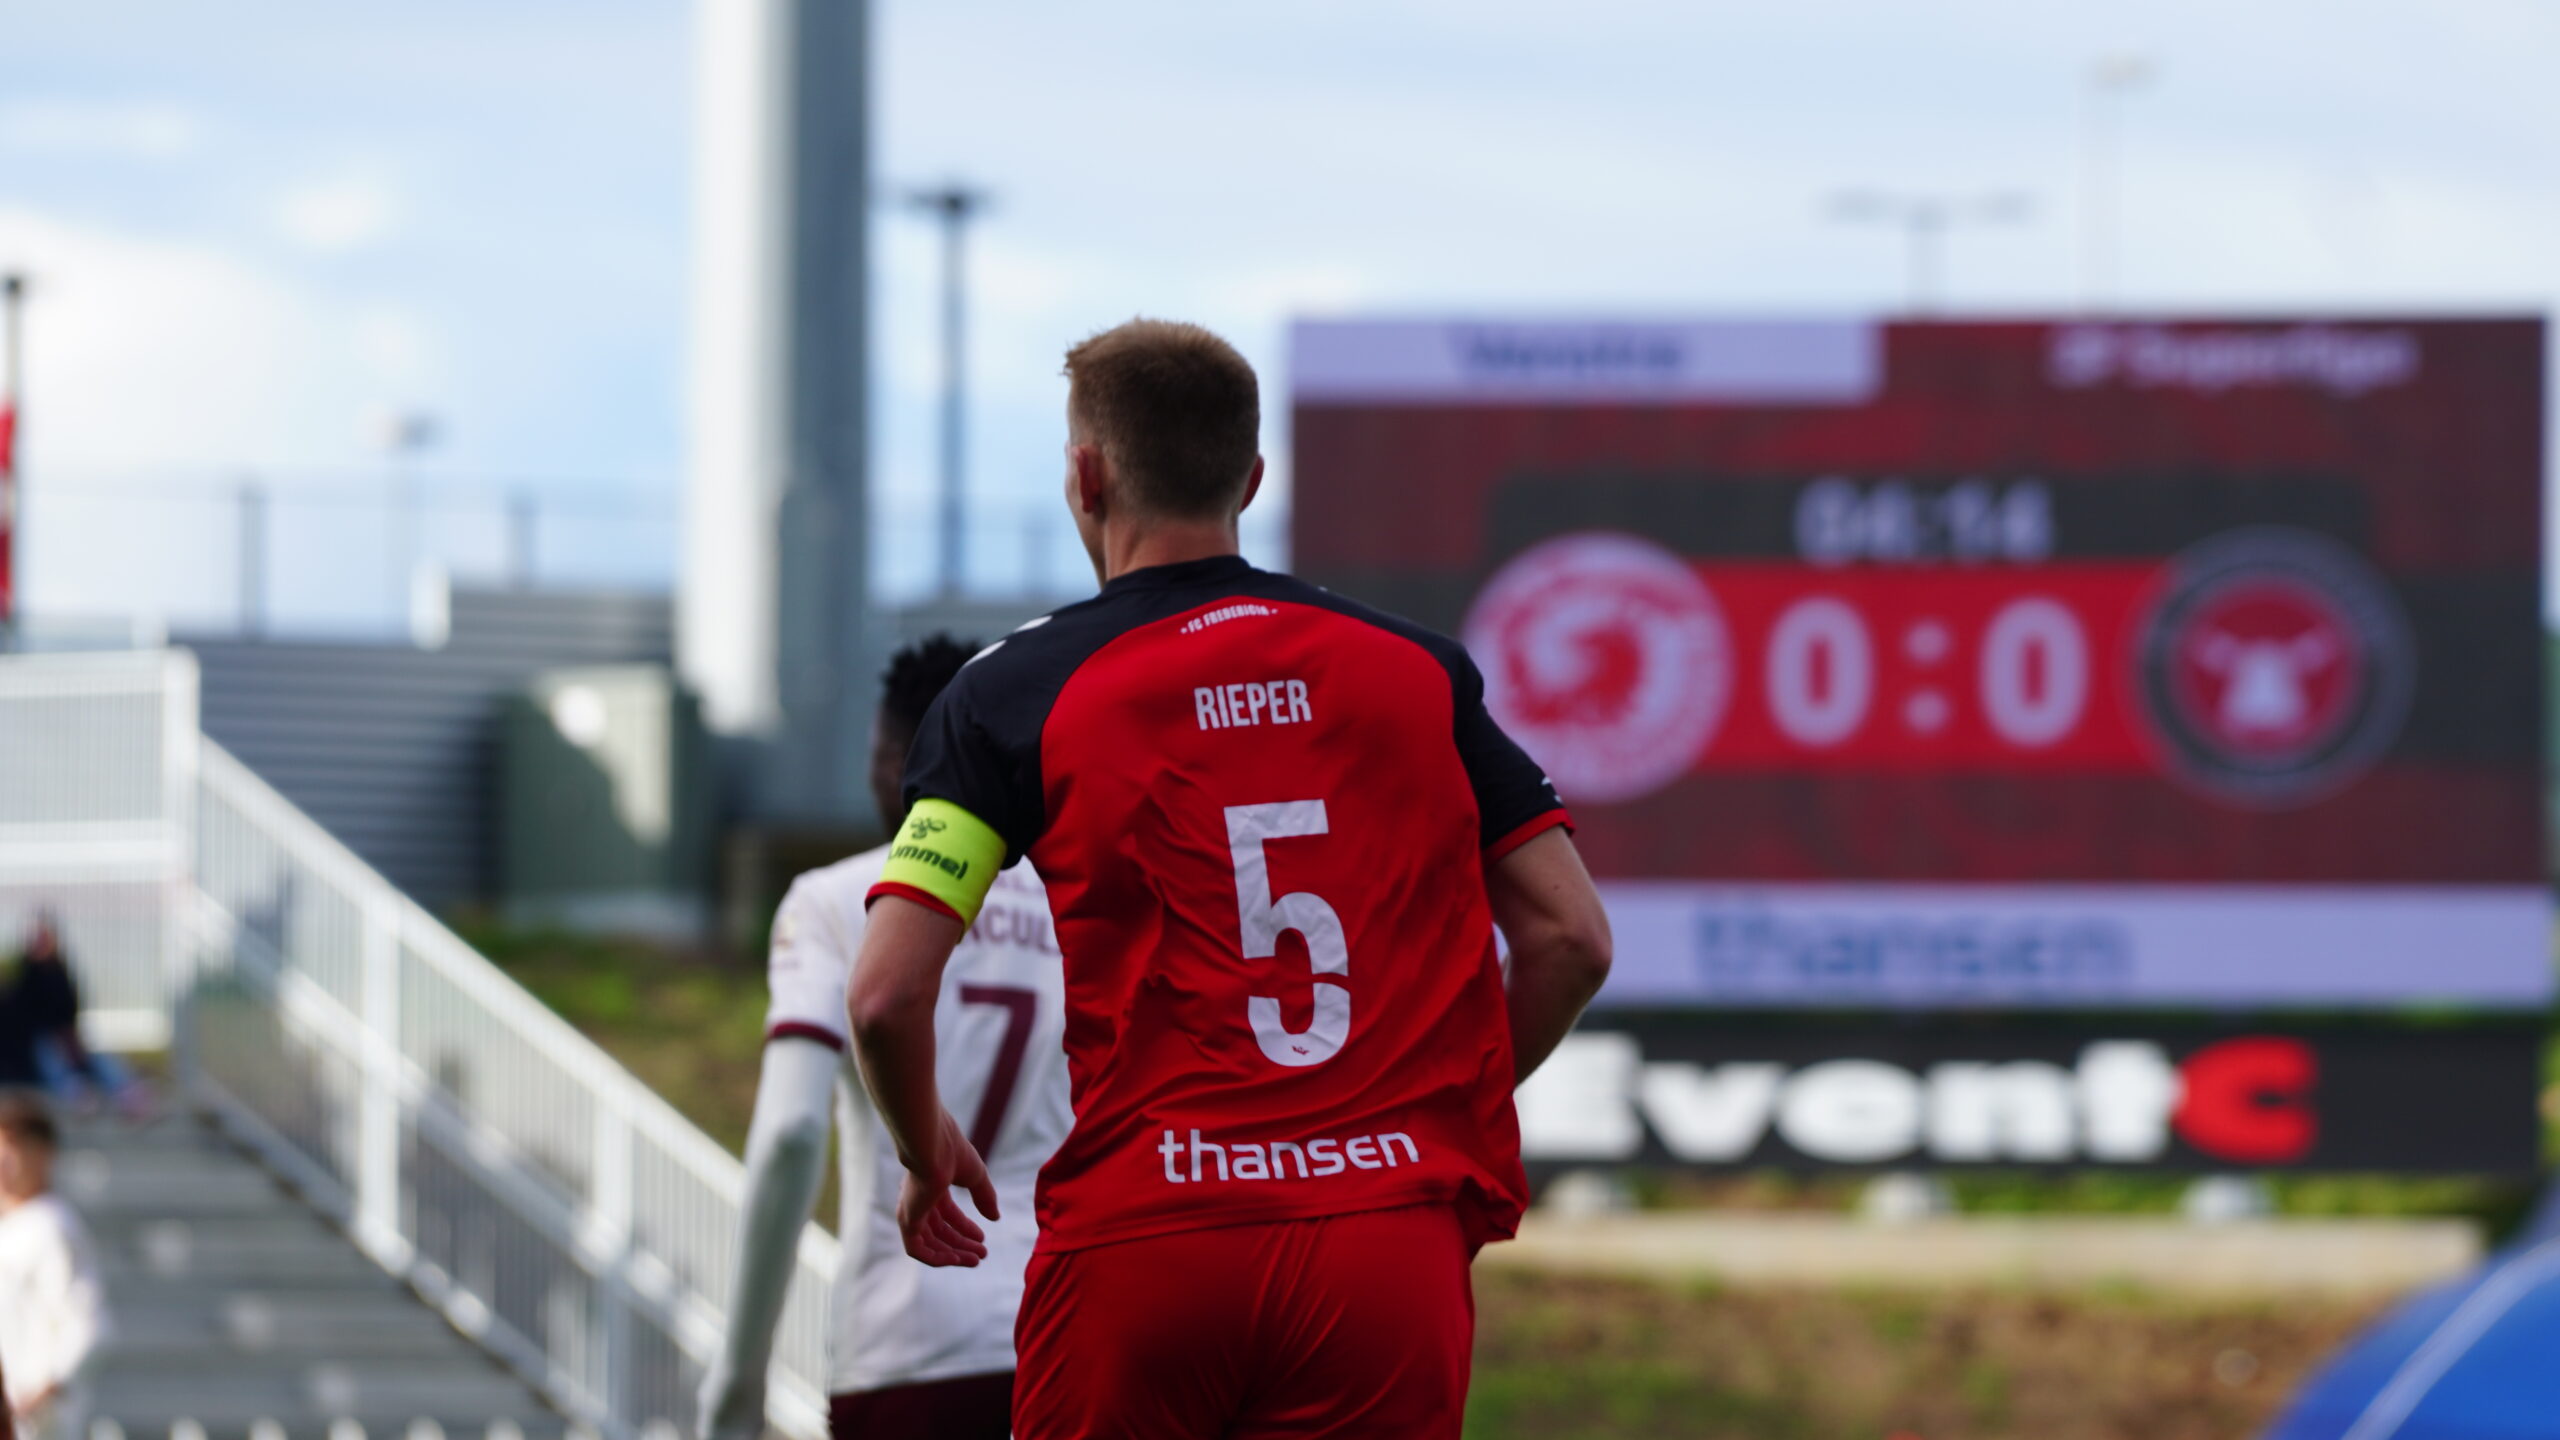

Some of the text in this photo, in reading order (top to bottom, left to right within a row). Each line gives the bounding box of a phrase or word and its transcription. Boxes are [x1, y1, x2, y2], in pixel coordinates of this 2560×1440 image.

[1187, 604, 1269, 633] FC FREDERICIA
[1194, 679, 1312, 731] RIEPER
[888, 845, 969, 881] ummel
[1223, 799, 1351, 1067] 5
[959, 983, 1038, 1165] 7
[1158, 1128, 1419, 1183] thansen
